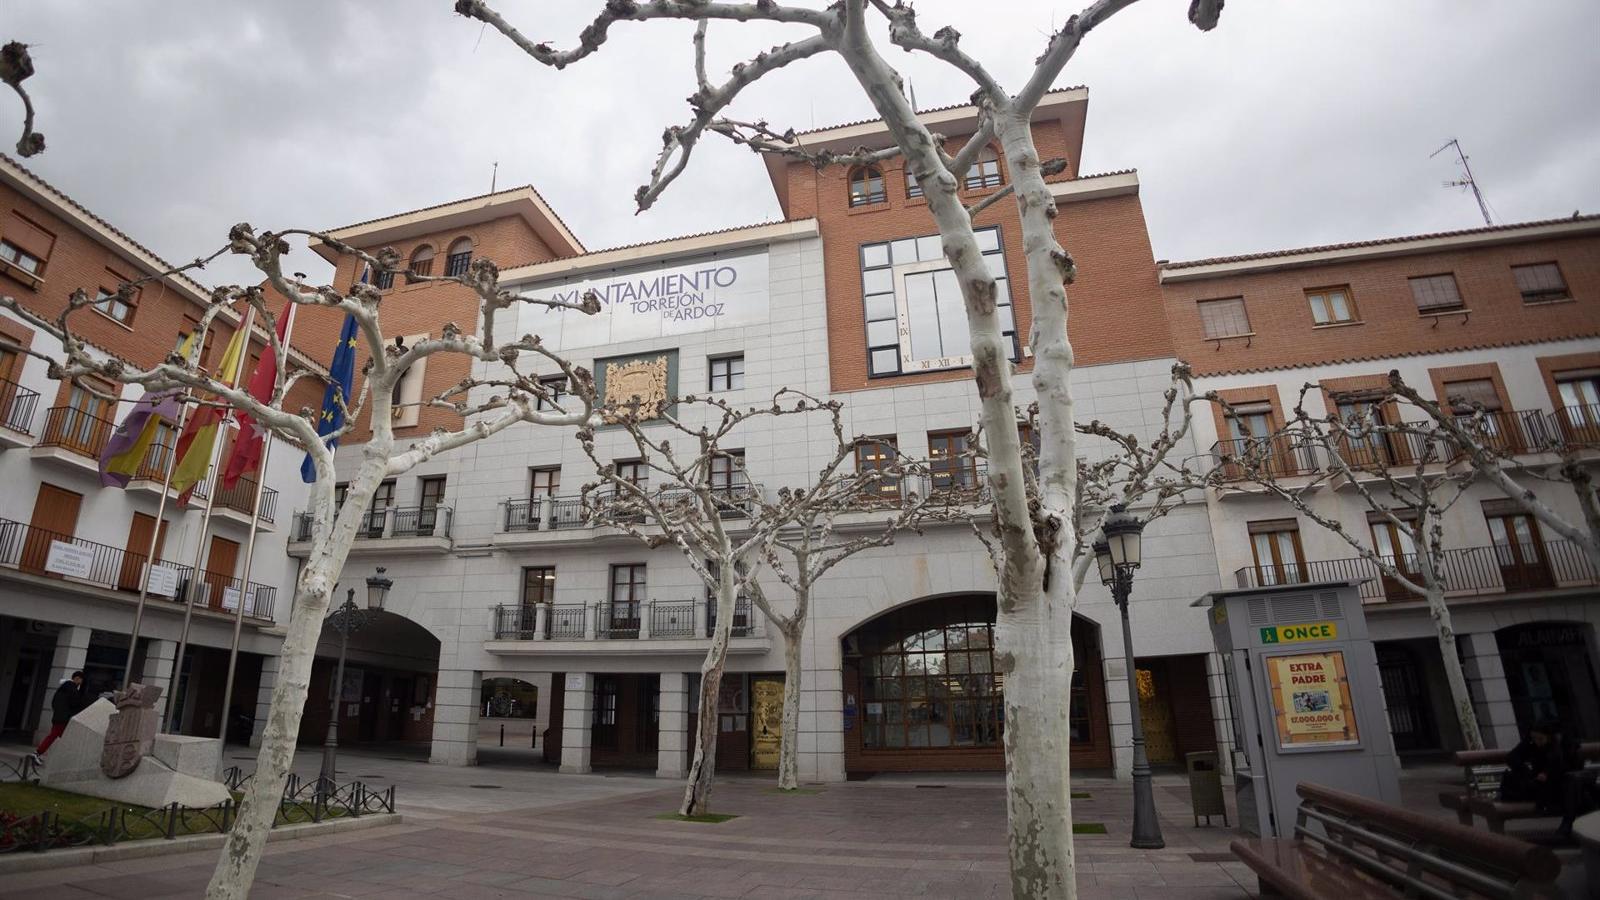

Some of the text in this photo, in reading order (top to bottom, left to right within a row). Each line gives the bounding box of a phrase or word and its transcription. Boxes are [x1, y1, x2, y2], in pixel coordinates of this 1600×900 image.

[630, 291, 704, 314] TORREJÓN
[673, 303, 725, 322] ARDOZ
[1283, 625, 1331, 640] ONCE
[1289, 662, 1324, 672] EXTRA
[1291, 674, 1326, 685] PADRE
